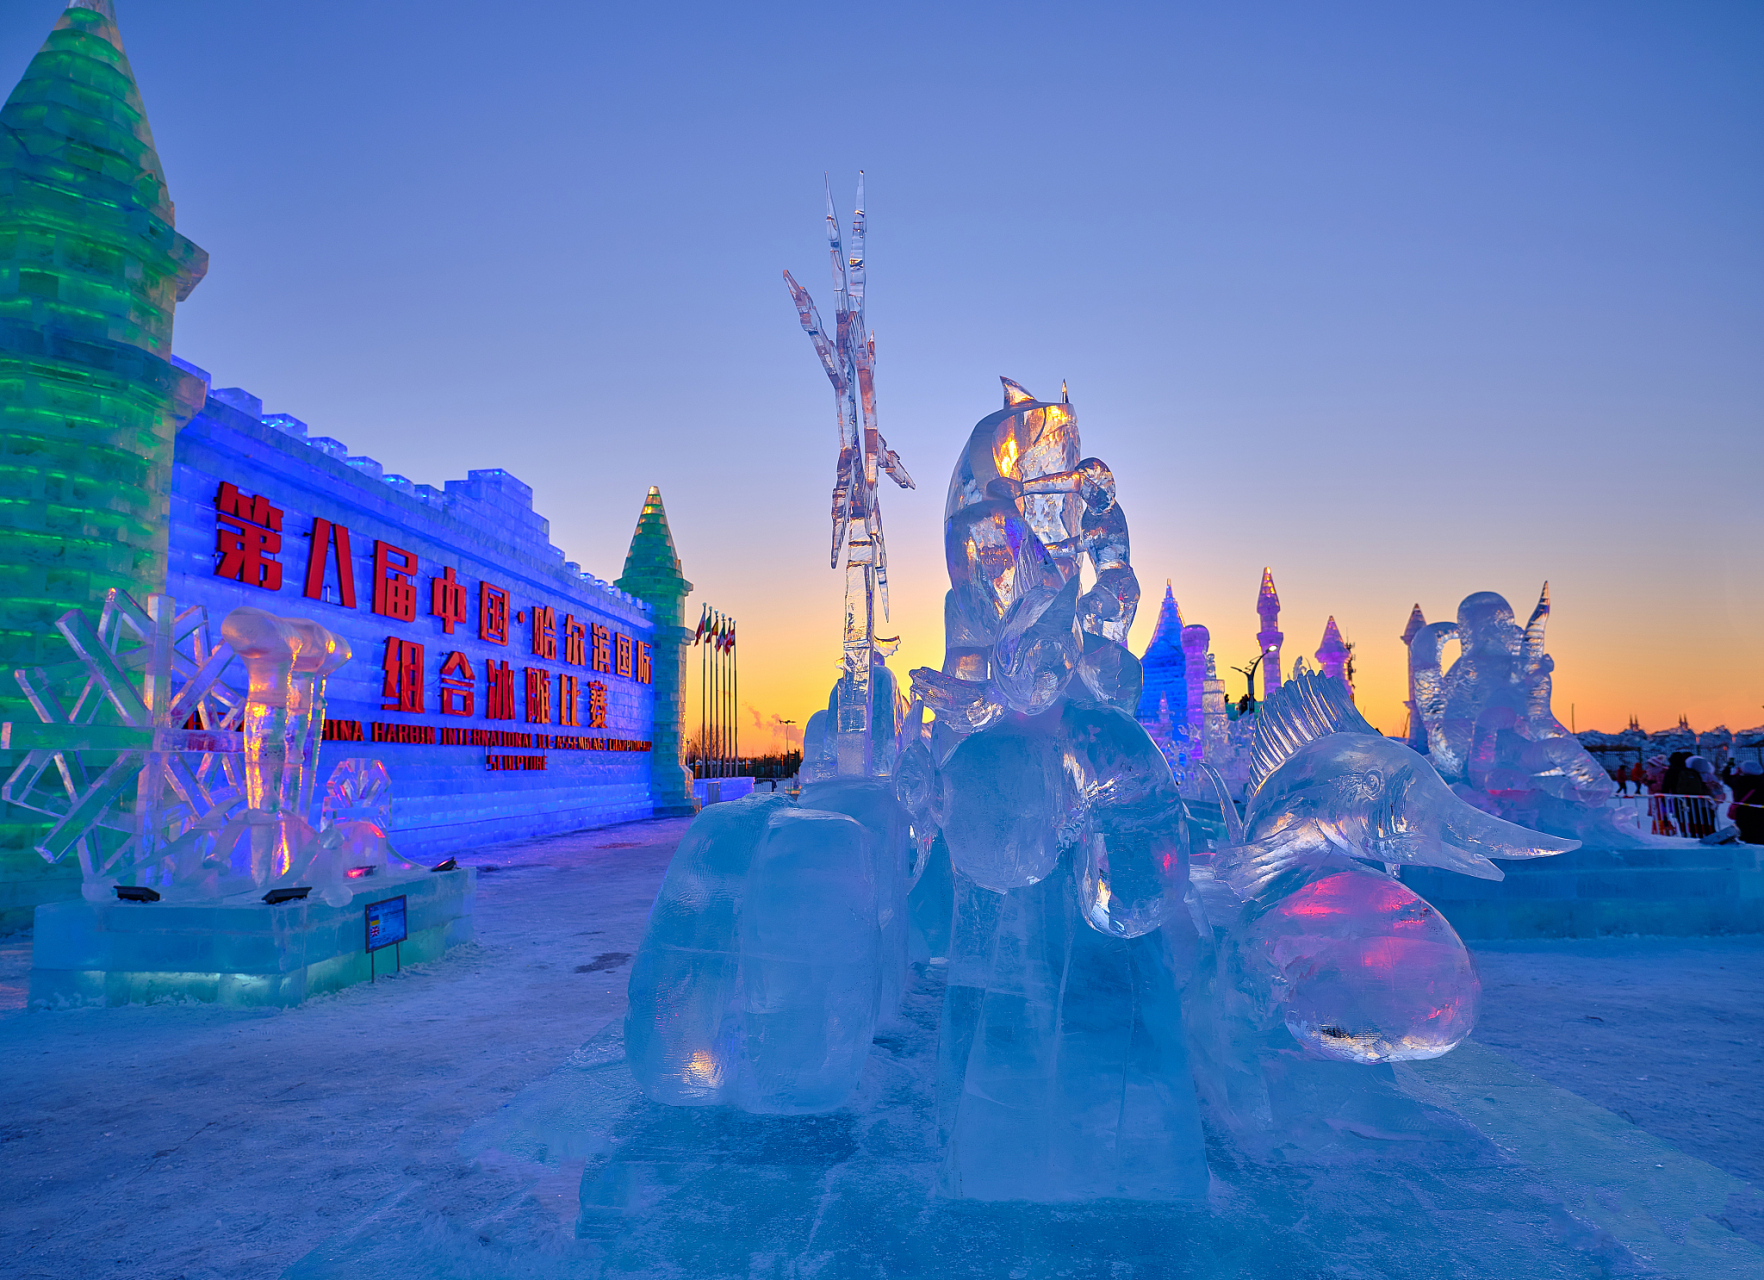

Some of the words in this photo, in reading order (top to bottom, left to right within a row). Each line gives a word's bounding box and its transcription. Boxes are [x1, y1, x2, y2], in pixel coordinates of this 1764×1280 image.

[381, 637, 608, 729] 组合冰雕比赛
[371, 721, 435, 745] HARBIN
[439, 727, 534, 749] INTERNATIONAL
[486, 755, 547, 770] SCULPTURE
